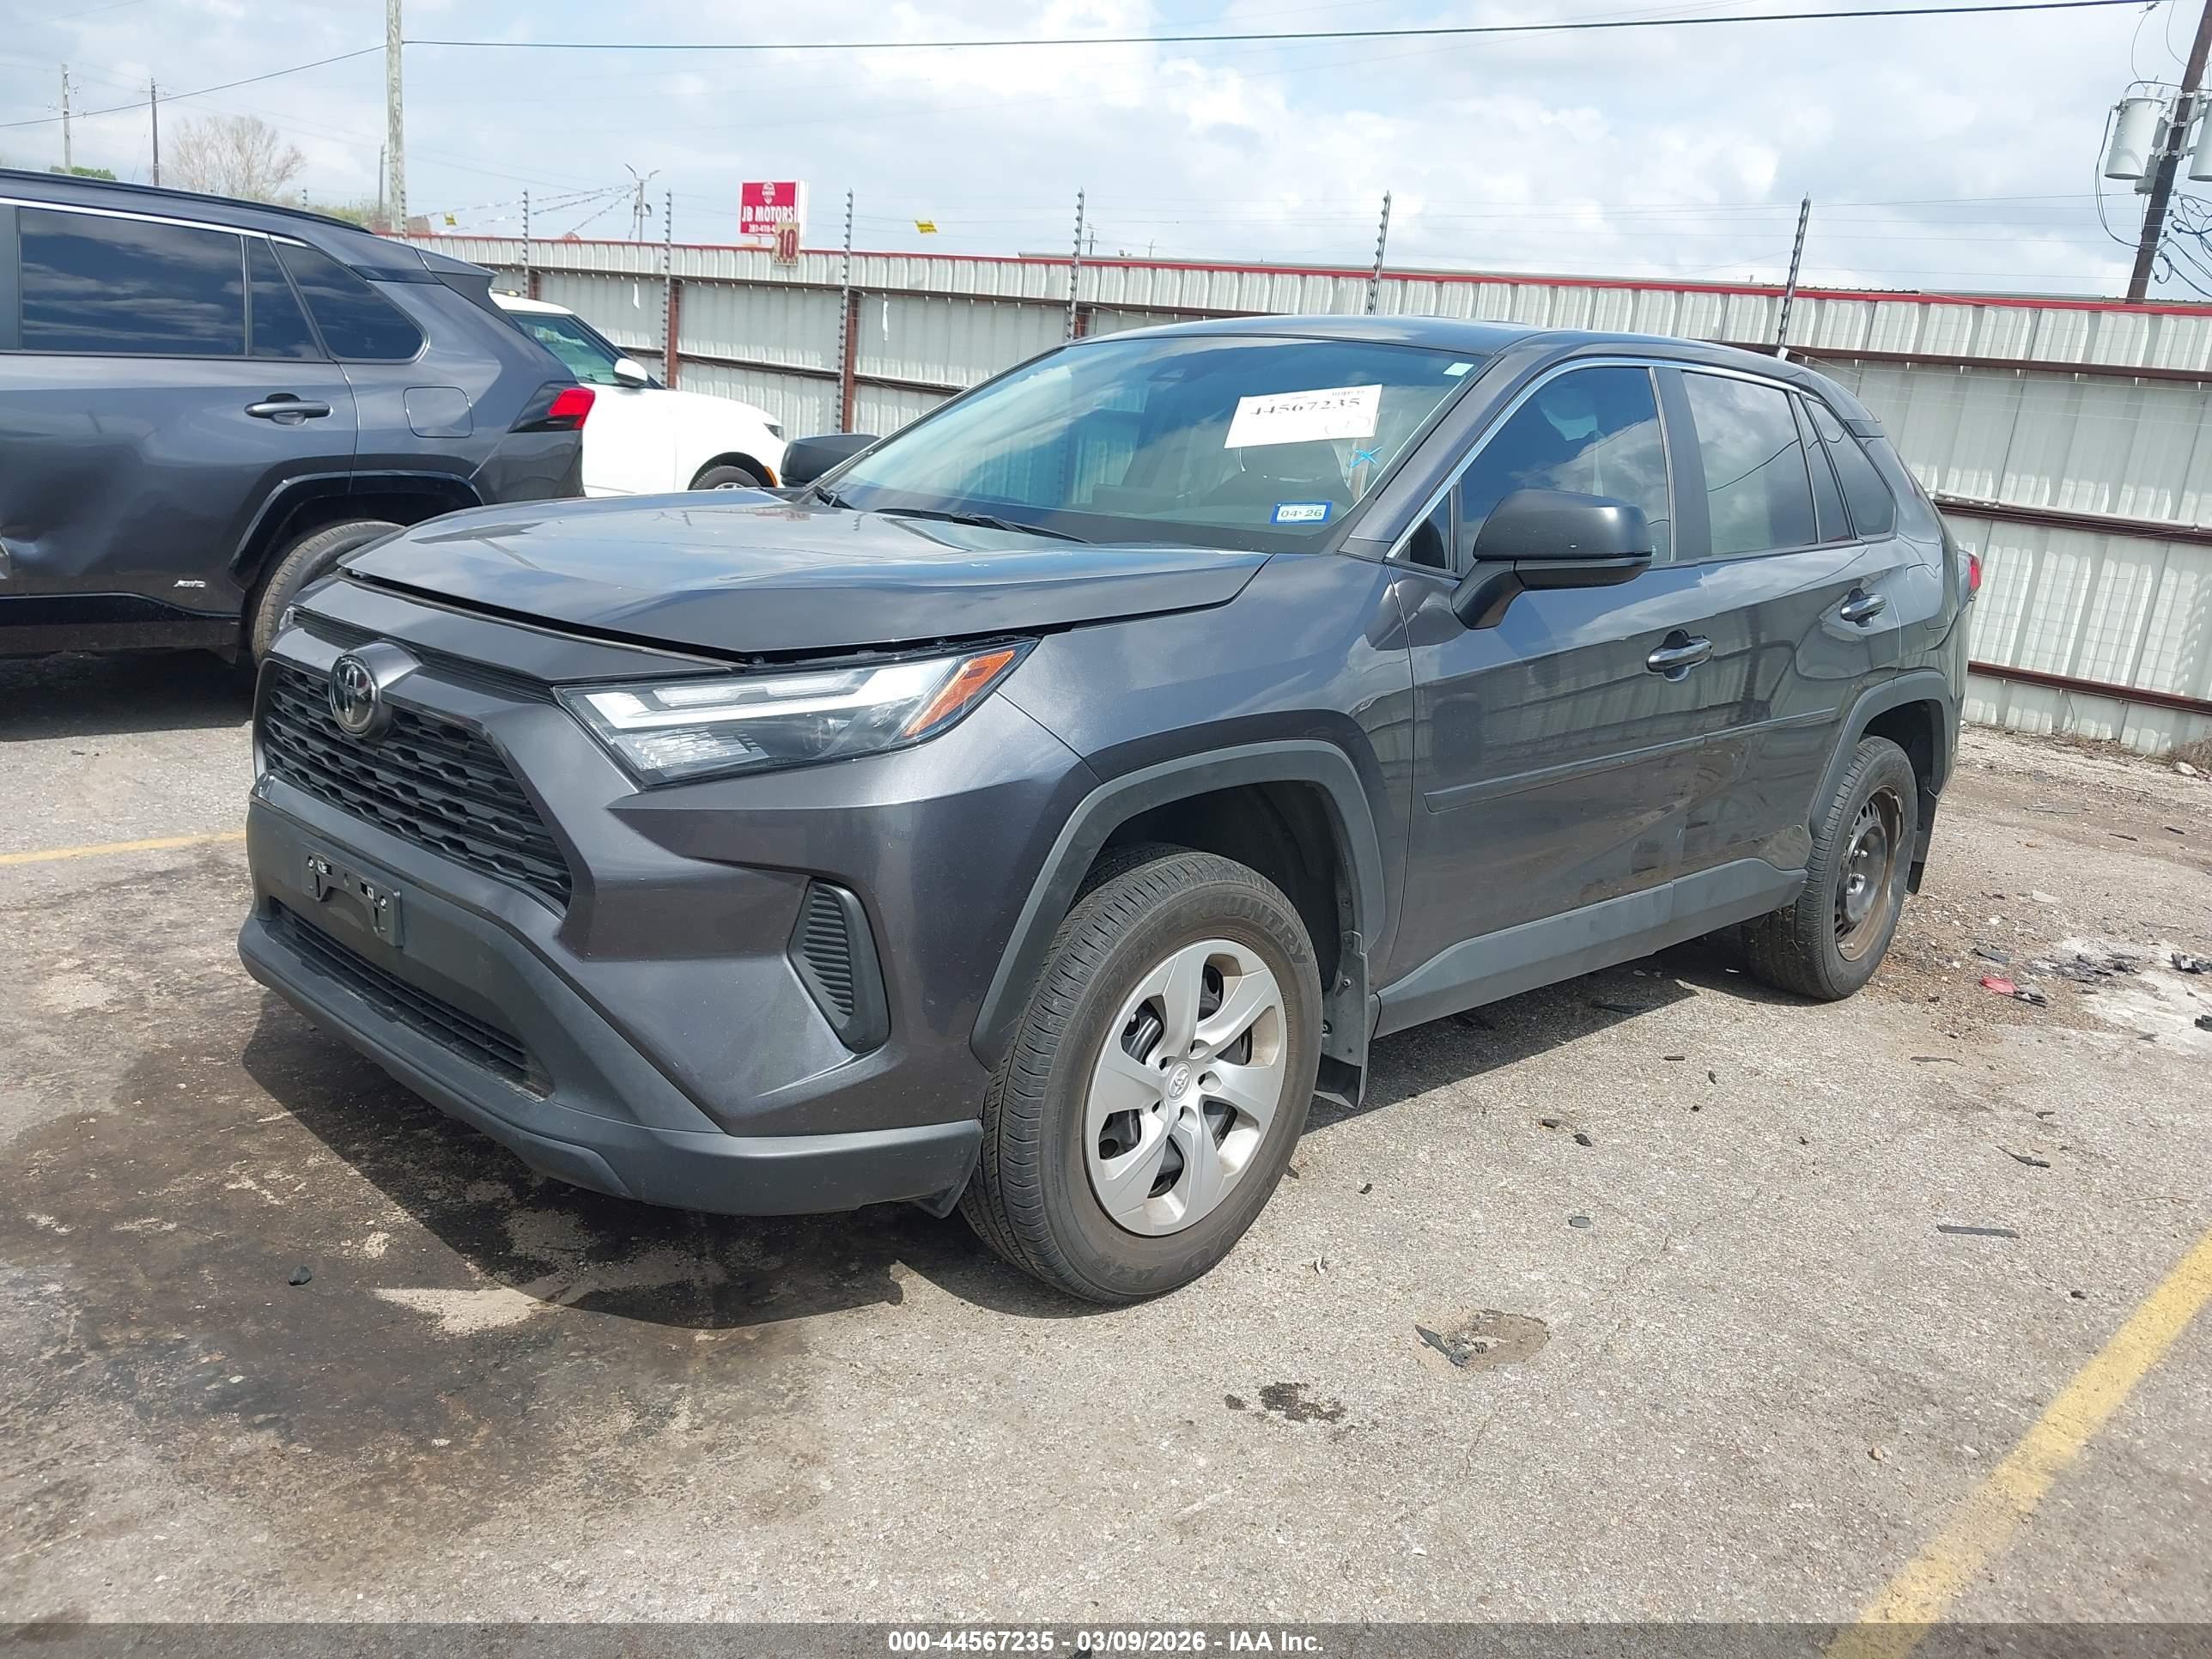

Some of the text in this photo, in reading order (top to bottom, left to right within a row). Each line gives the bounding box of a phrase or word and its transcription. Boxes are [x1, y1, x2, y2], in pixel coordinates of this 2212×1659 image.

[741, 205, 794, 222] JB MOTORS
[1250, 398, 1361, 416] 44567235
